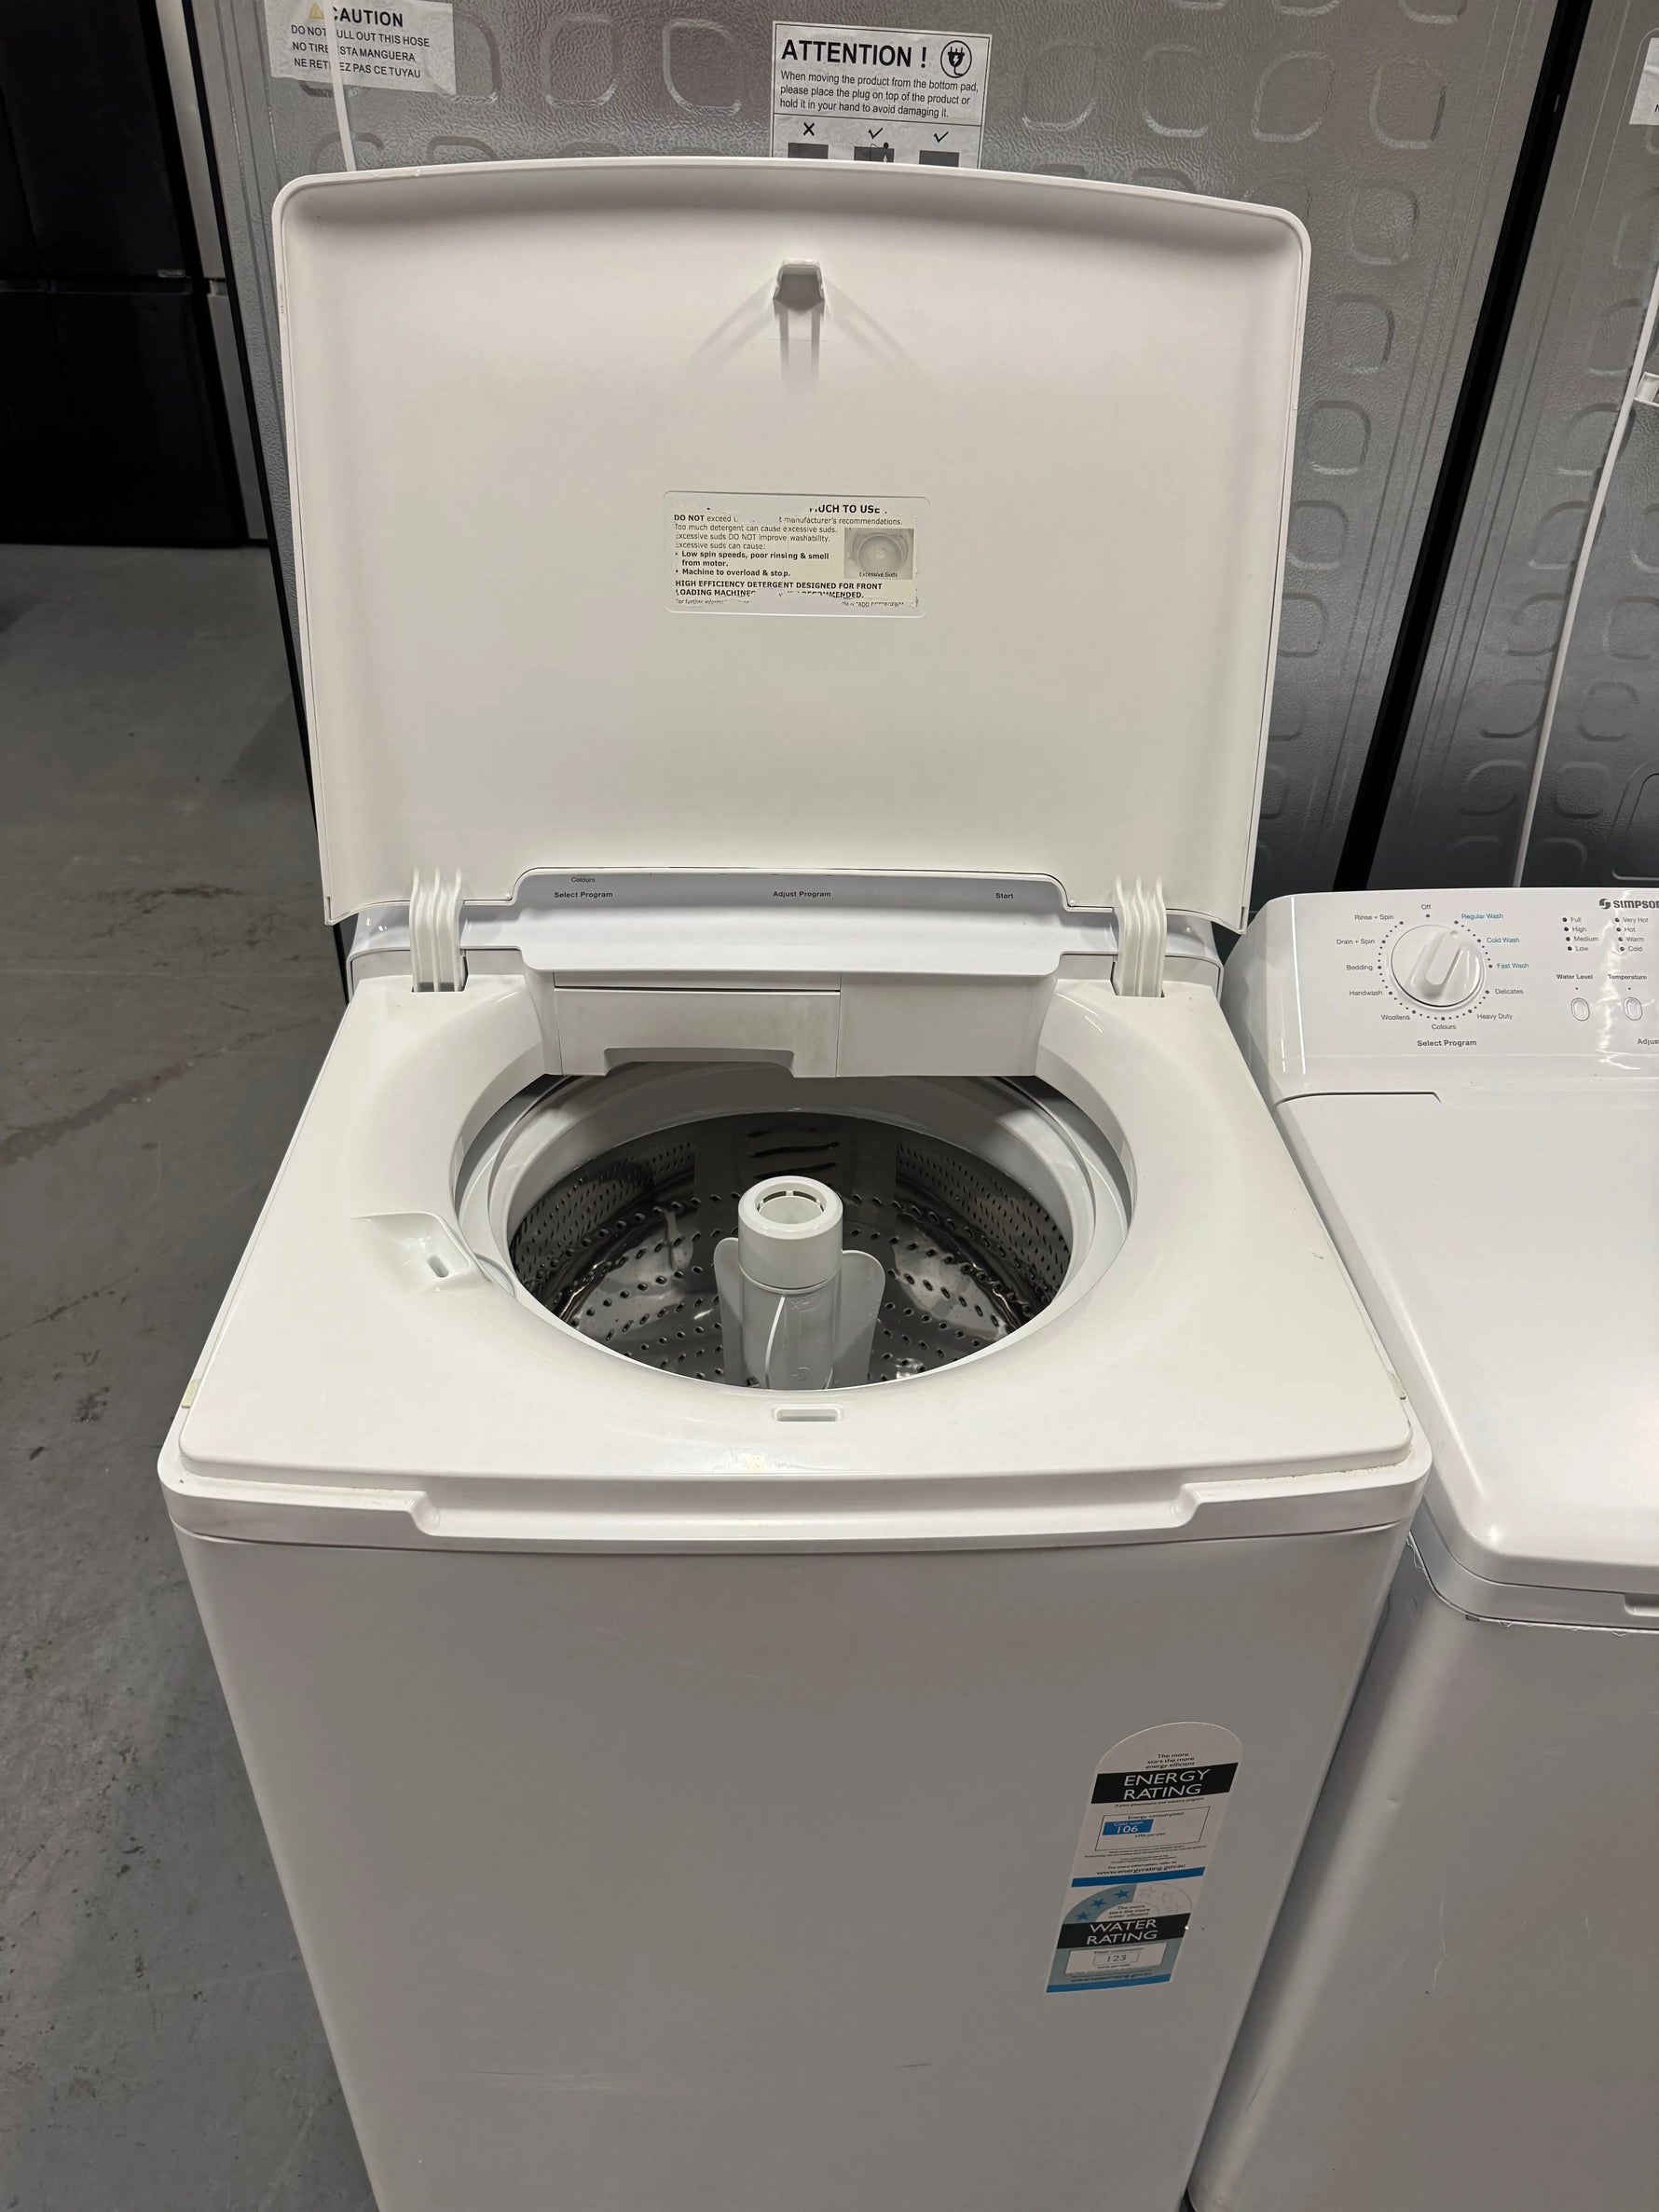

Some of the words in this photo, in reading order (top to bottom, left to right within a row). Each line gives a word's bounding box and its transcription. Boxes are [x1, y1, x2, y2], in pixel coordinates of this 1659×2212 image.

[333, 7, 403, 27] AUTION
[292, 24, 305, 34] DO
[308, 26, 326, 36] NOT
[336, 30, 354, 39] ULL
[356, 32, 376, 41] OUT
[378, 34, 401, 44] THIS
[403, 36, 430, 47] HOSE
[293, 42, 307, 51] NO
[339, 46, 358, 56] STA
[360, 48, 416, 62] MANGUERA
[781, 39, 912, 68] ATTENTION
[295, 58, 308, 67] NE
[353, 63, 371, 74] PAS
[374, 65, 387, 75] CE
[389, 67, 420, 78] TUYAU
[781, 70, 805, 80] When
[809, 74, 839, 85] moving
[842, 75, 855, 84] the
[857, 76, 889, 87] product
[892, 77, 911, 88] from
[913, 79, 926, 88] the
[929, 79, 957, 89] bottom
[960, 82, 979, 92] pad,
[780, 86, 808, 95] please
[811, 87, 833, 97] place
[836, 89, 849, 97] the
[852, 89, 870, 100] plug
[872, 91, 883, 100] on
[885, 91, 898, 102] top
[901, 92, 910, 101] of
[912, 93, 925, 102] the
[927, 94, 959, 104] product
[780, 98, 798, 108] hold
[801, 100, 805, 108] it
[808, 100, 816, 109] in
[817, 102, 837, 111] your
[839, 102, 859, 112] hand
[862, 103, 871, 112] to
[872, 104, 896, 114] avoid
[898, 105, 939, 118] damaging
[843, 504, 857, 514] TO
[710, 524, 744, 532] detergent
[759, 534, 787, 543] improve
[790, 535, 830, 543] washability.
[700, 551, 716, 559] spin
[719, 551, 747, 559] speeds,
[770, 552, 798, 561] rinsing
[770, 570, 790, 578] stop.
[698, 580, 745, 588] EFFICIENCY
[1123, 1768, 1212, 1787] ENERGY
[1123, 1783, 1202, 1801] RATING
[1117, 1824, 1139, 1834] 106
[1090, 1918, 1158, 1933] WATER
[1086, 1930, 1159, 1945] RATING
[1107, 1954, 1127, 1962] 123
